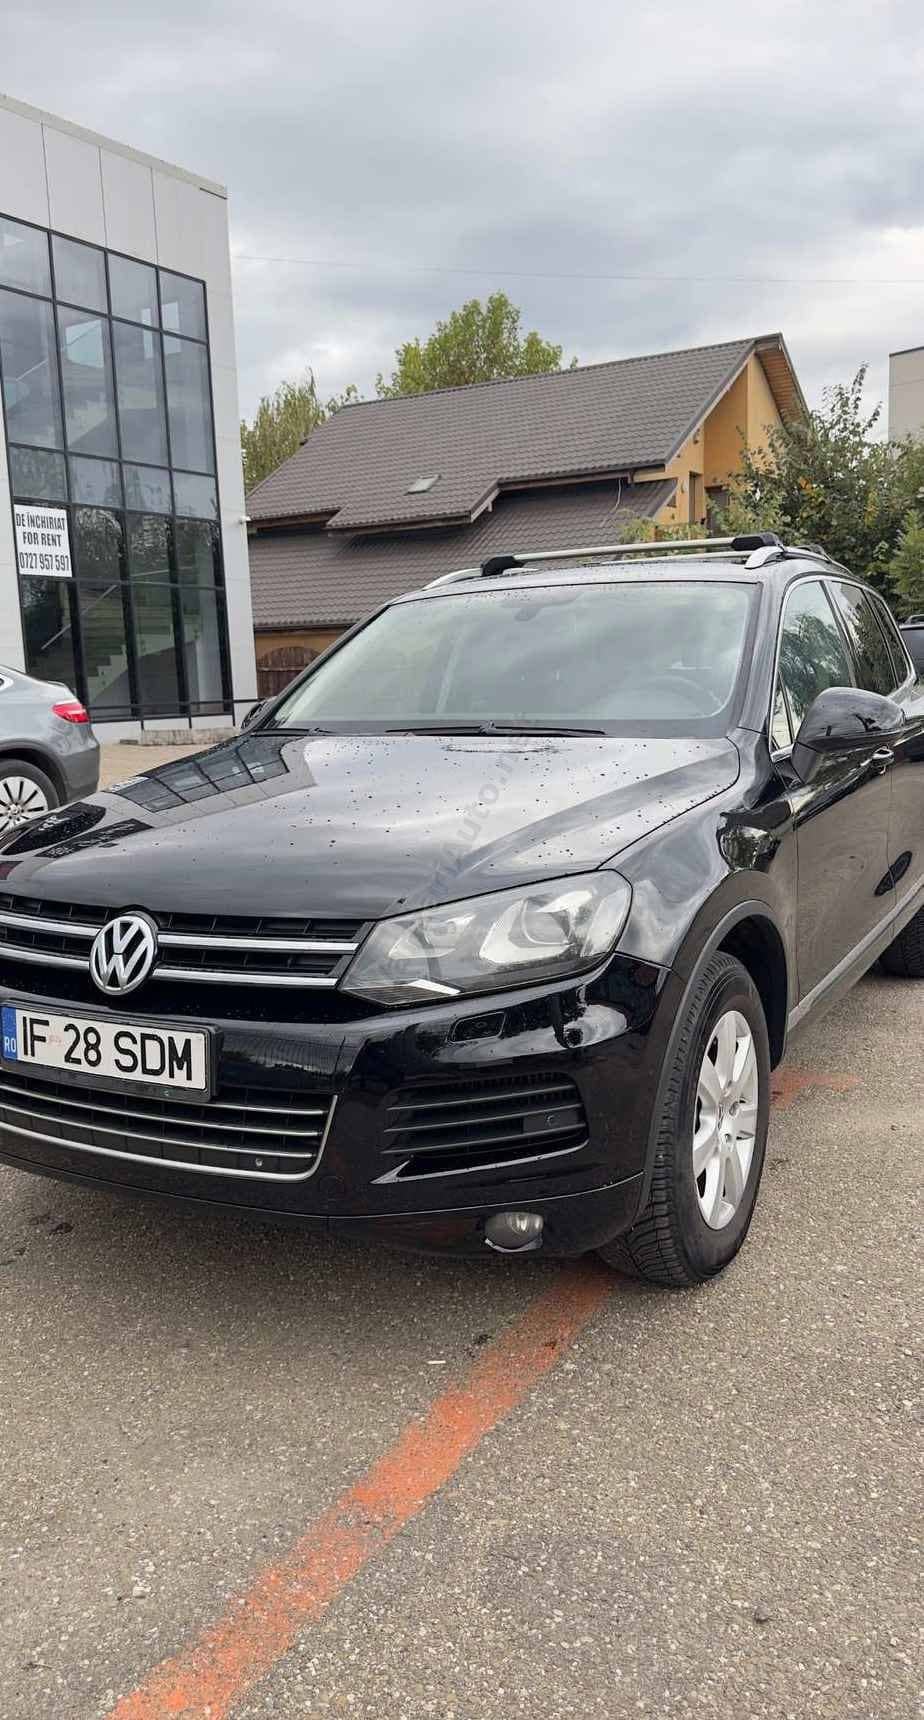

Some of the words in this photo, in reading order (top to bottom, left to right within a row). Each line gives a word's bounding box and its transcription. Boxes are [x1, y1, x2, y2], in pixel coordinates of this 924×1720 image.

[16, 513, 26, 527] DE
[22, 531, 39, 545] FOR
[41, 533, 62, 547] RENT
[19, 552, 38, 569] 0727
[39, 553, 54, 570] 957
[4, 1036, 17, 1053] RO
[22, 1015, 50, 1057] IF
[63, 1023, 101, 1067] 28
[113, 1030, 193, 1081] SDM
